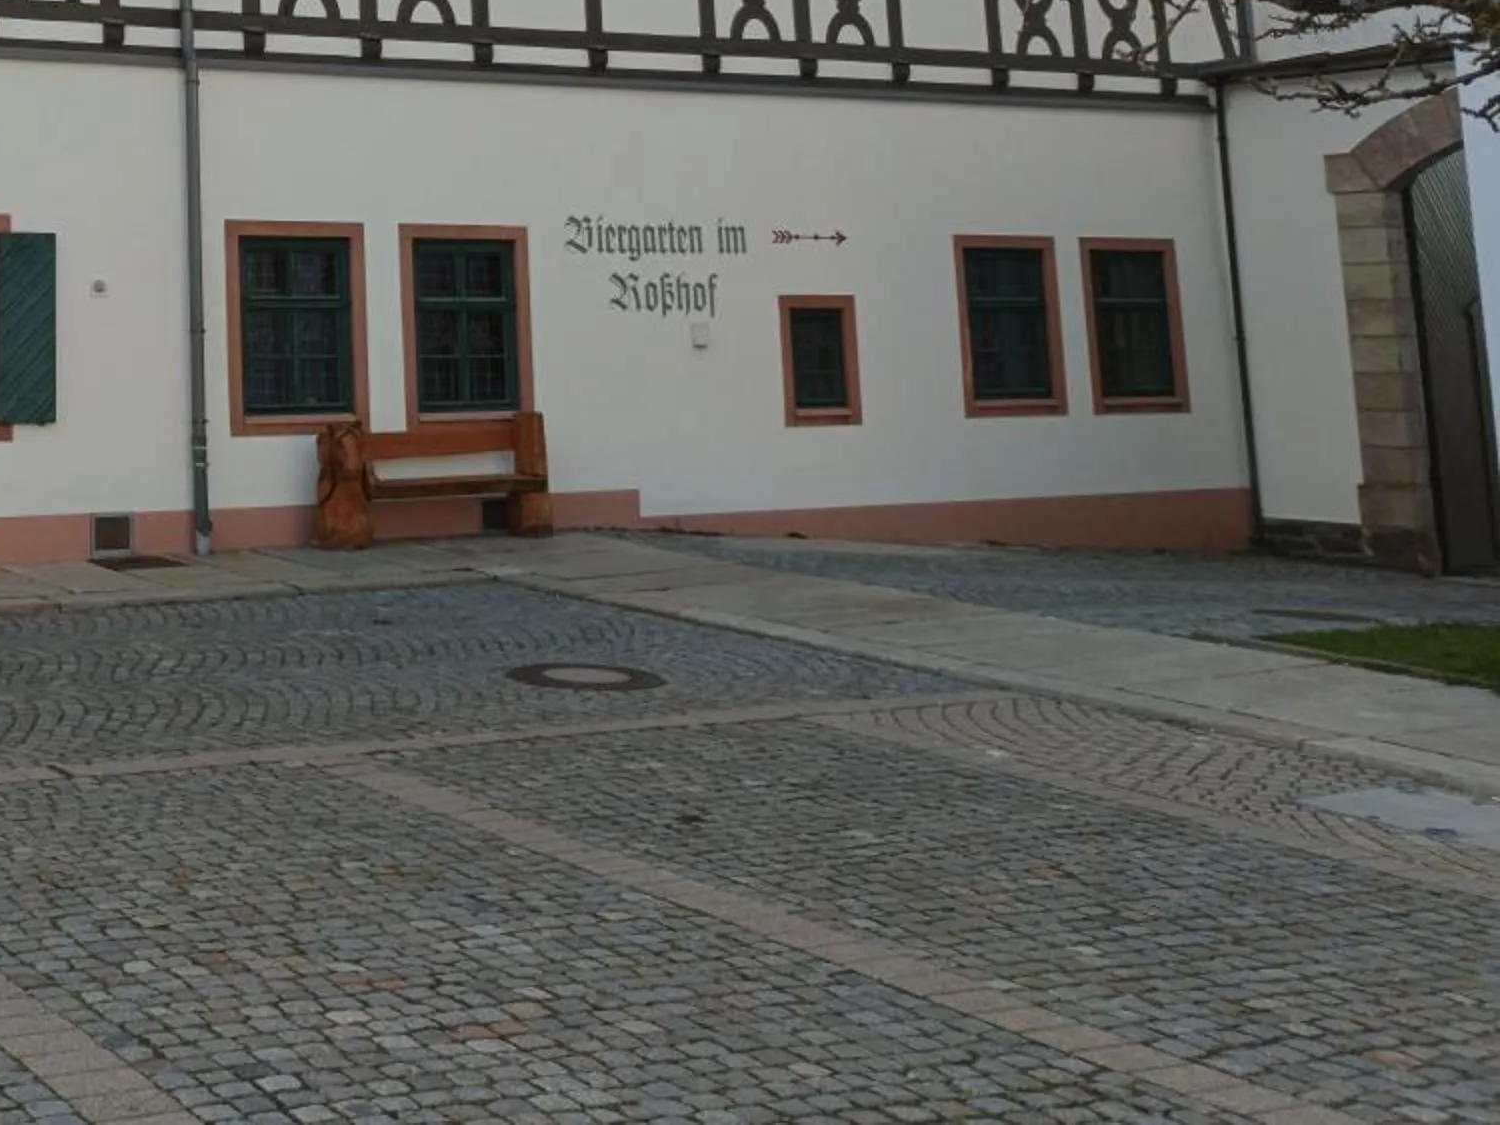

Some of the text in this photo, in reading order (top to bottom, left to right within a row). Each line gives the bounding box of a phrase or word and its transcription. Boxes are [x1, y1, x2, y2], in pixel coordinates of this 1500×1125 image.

[564, 215, 747, 261] Biergarten im
[608, 272, 718, 317] Roßhof
